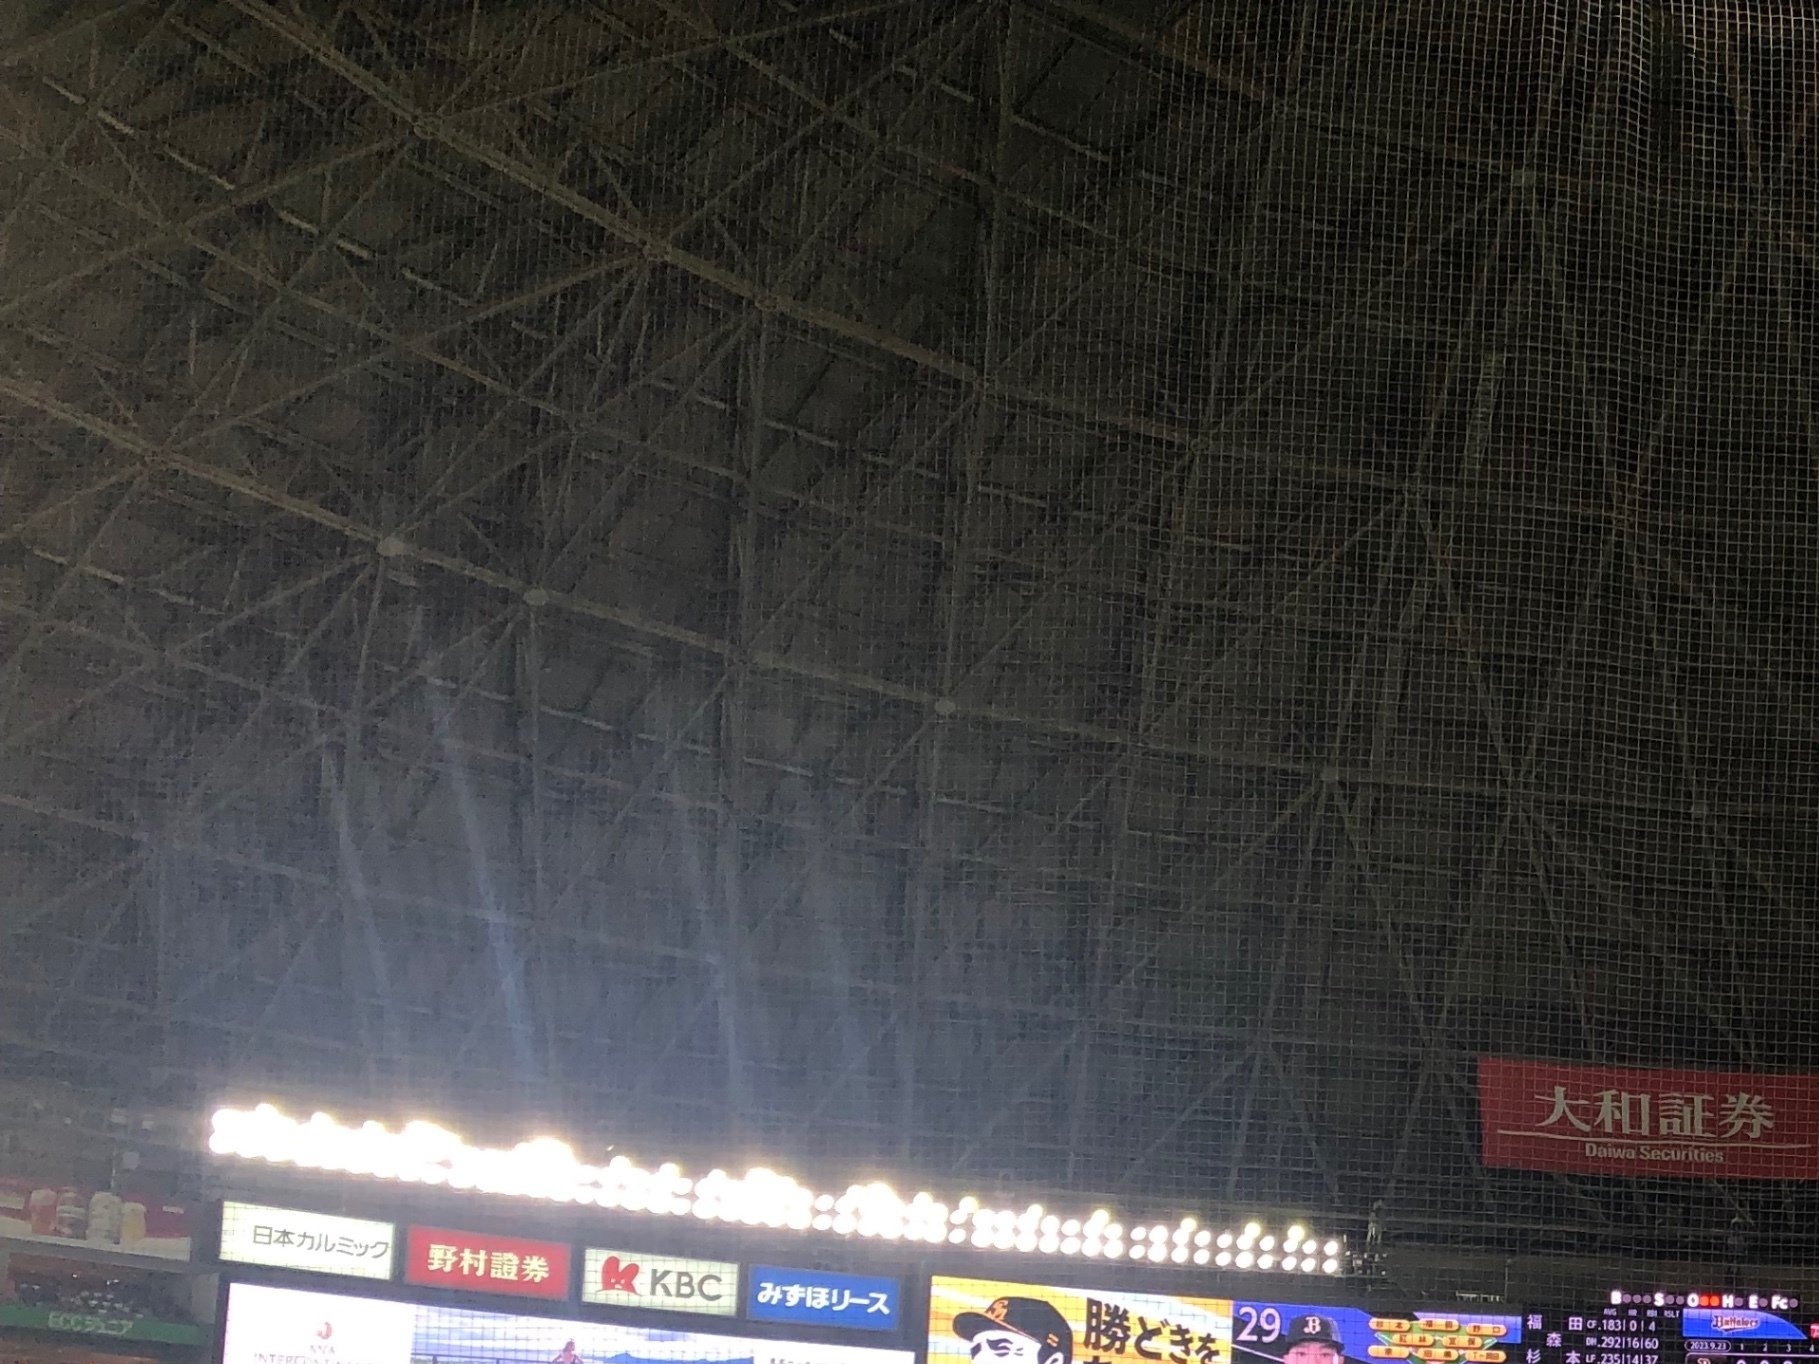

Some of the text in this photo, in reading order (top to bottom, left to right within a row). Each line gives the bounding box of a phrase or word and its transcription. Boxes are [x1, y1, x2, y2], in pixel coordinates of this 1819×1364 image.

[1534, 1085, 1775, 1139] 大和証券
[1585, 1143, 1724, 1163] Daiwa Securities
[253, 1224, 389, 1261] 日本カルミック
[428, 1242, 549, 1284] 野村證券
[651, 1268, 722, 1302] KBC
[757, 1282, 891, 1315] みずほリース
[1237, 1307, 1280, 1343] 29
[1598, 1320, 1622, 1331] .183
[1597, 1337, 1621, 1349] .292
[1597, 1354, 1621, 1364] .235
